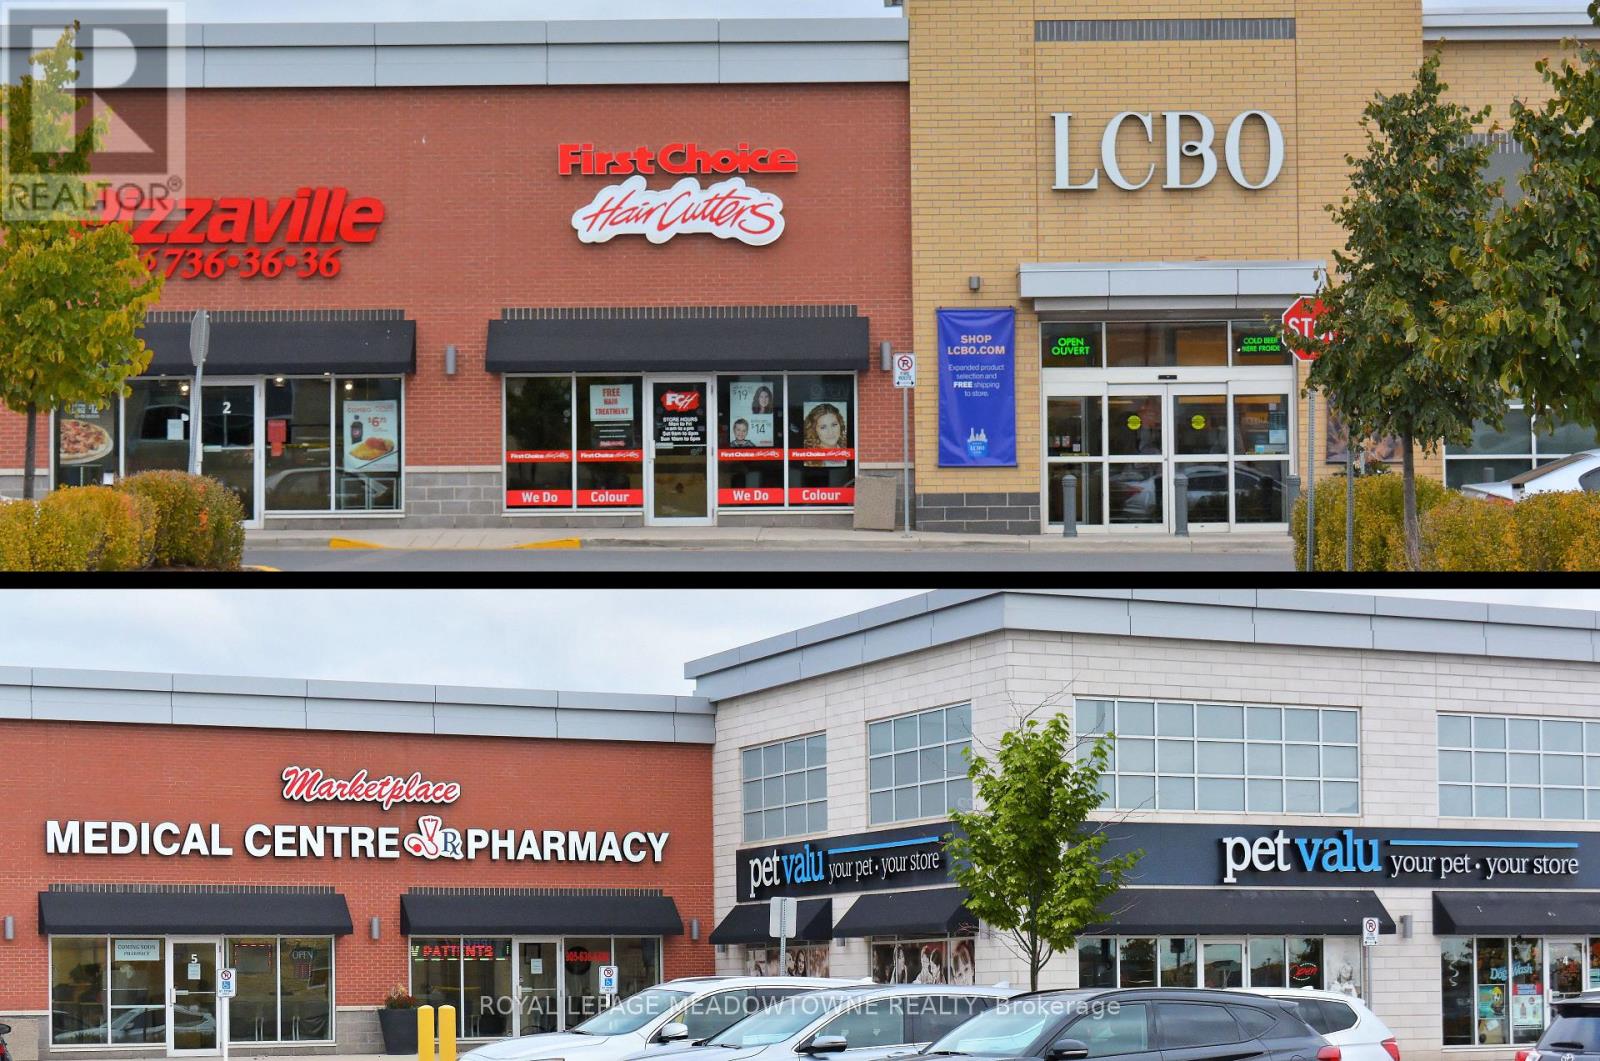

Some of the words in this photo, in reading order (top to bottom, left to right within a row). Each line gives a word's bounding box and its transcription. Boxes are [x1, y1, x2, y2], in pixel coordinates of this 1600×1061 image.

[1050, 110, 1285, 190] LCBO
[558, 143, 654, 174] First
[657, 143, 797, 173] Choice
[960, 334, 992, 344] SHOP
[1057, 337, 1084, 347] OPEN
[947, 346, 1005, 355] LCBO.COM
[1051, 346, 1090, 355] OUVERT
[948, 364, 979, 372] Expanded
[980, 364, 1005, 372] product
[953, 381, 973, 389] FREE
[974, 381, 1000, 390] shipping
[602, 387, 621, 398] FREE
[222, 401, 232, 415] 2
[521, 492, 540, 502] We
[543, 492, 558, 502] Do
[590, 491, 630, 502] Colour
[733, 490, 750, 500] We
[754, 490, 769, 500] Do
[802, 489, 841, 501] Colour
[283, 767, 460, 808] Marketplace
[45, 820, 233, 856] MEDICAL
[244, 824, 400, 858] CENTRE
[466, 828, 670, 863] PHARMACY
[1222, 829, 1291, 883] pet
[1294, 829, 1383, 873] valu
[1390, 854, 1436, 879] your
[1440, 854, 1471, 879] pet
[1486, 854, 1530, 881] your
[1533, 854, 1580, 875] store
[749, 849, 780, 898] pet
[781, 843, 825, 885] valu
[828, 862, 853, 885] your
[855, 859, 873, 882] pet
[881, 856, 908, 880] your
[910, 851, 940, 871] store
[423, 944, 494, 957] PATIENTS
[191, 954, 198, 964] 5
[1563, 955, 1569, 966] 4
[1490, 967, 1508, 981] Dog
[1512, 962, 1534, 977] Wash
